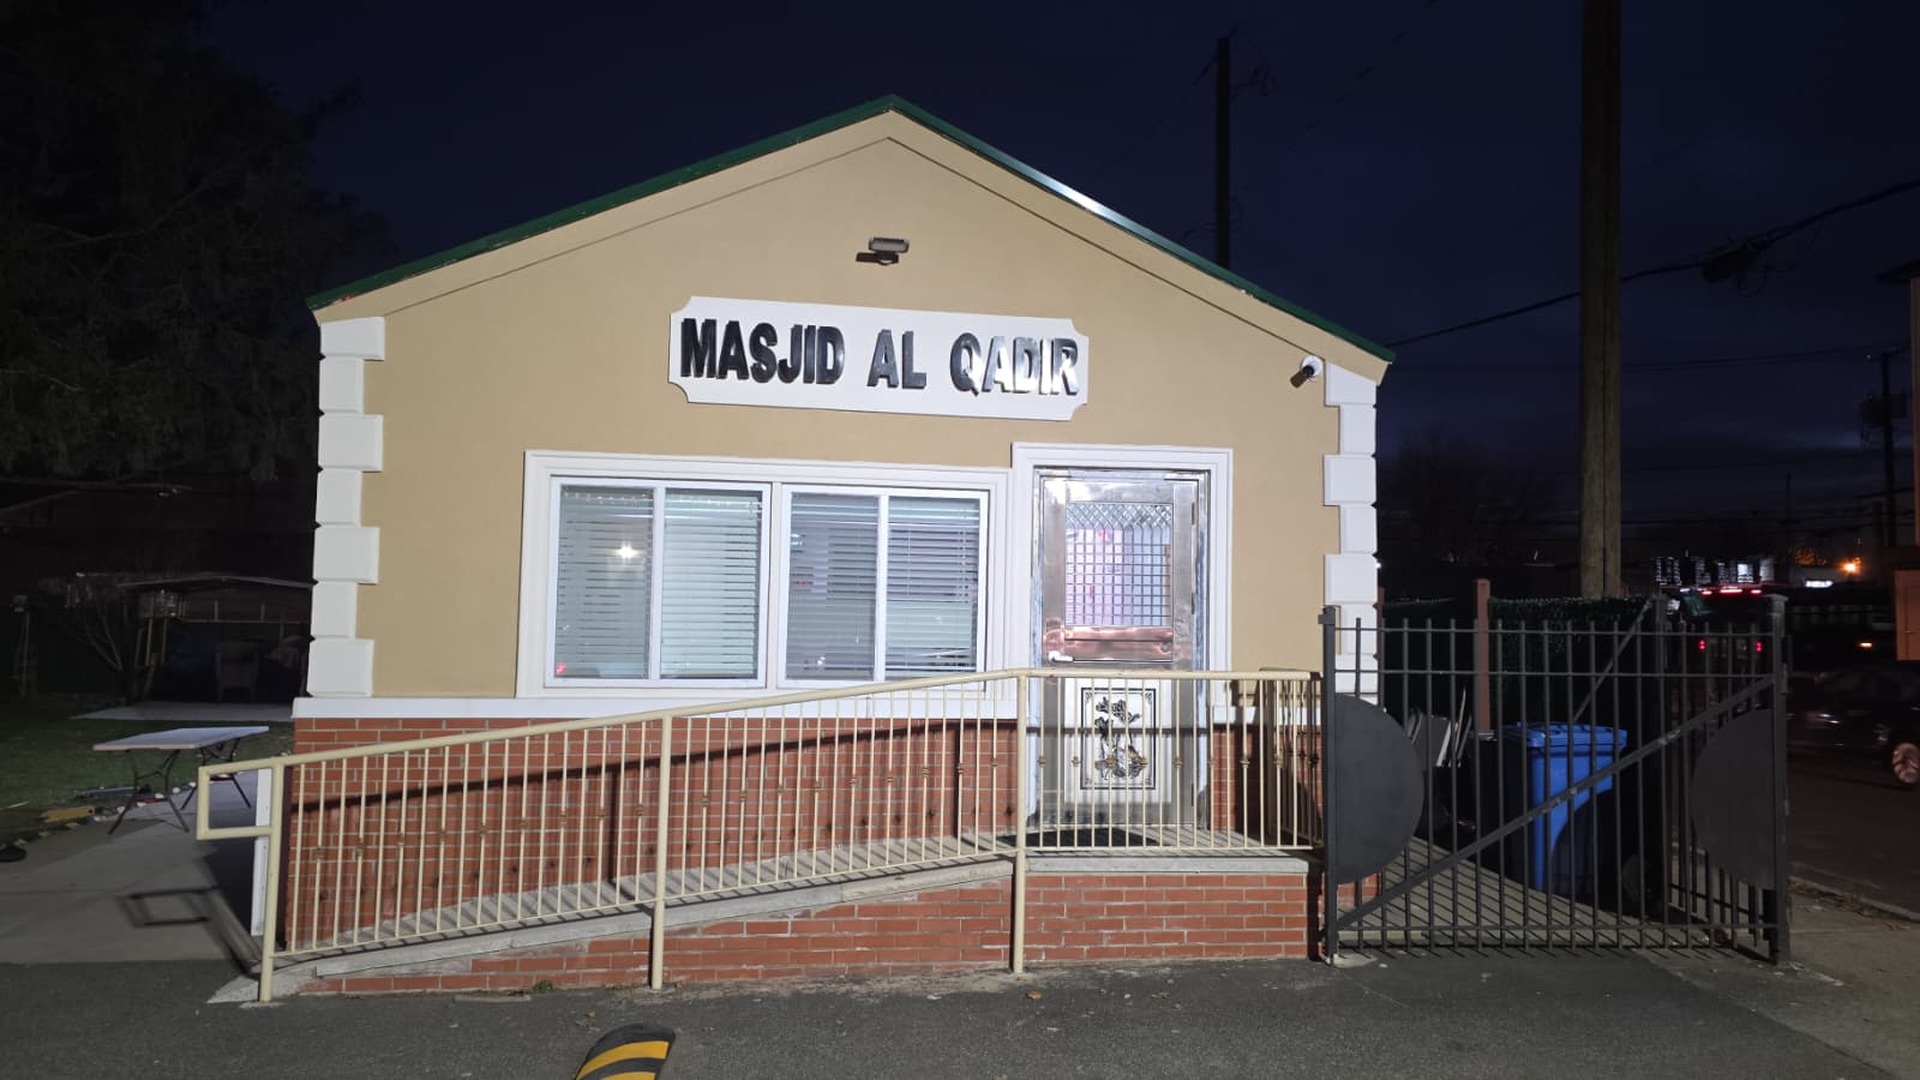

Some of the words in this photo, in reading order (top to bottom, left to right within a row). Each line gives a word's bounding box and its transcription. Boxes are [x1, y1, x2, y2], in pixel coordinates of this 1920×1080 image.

[681, 318, 845, 384] MASJID
[867, 329, 927, 389] AL
[950, 332, 1079, 396] QADIR
